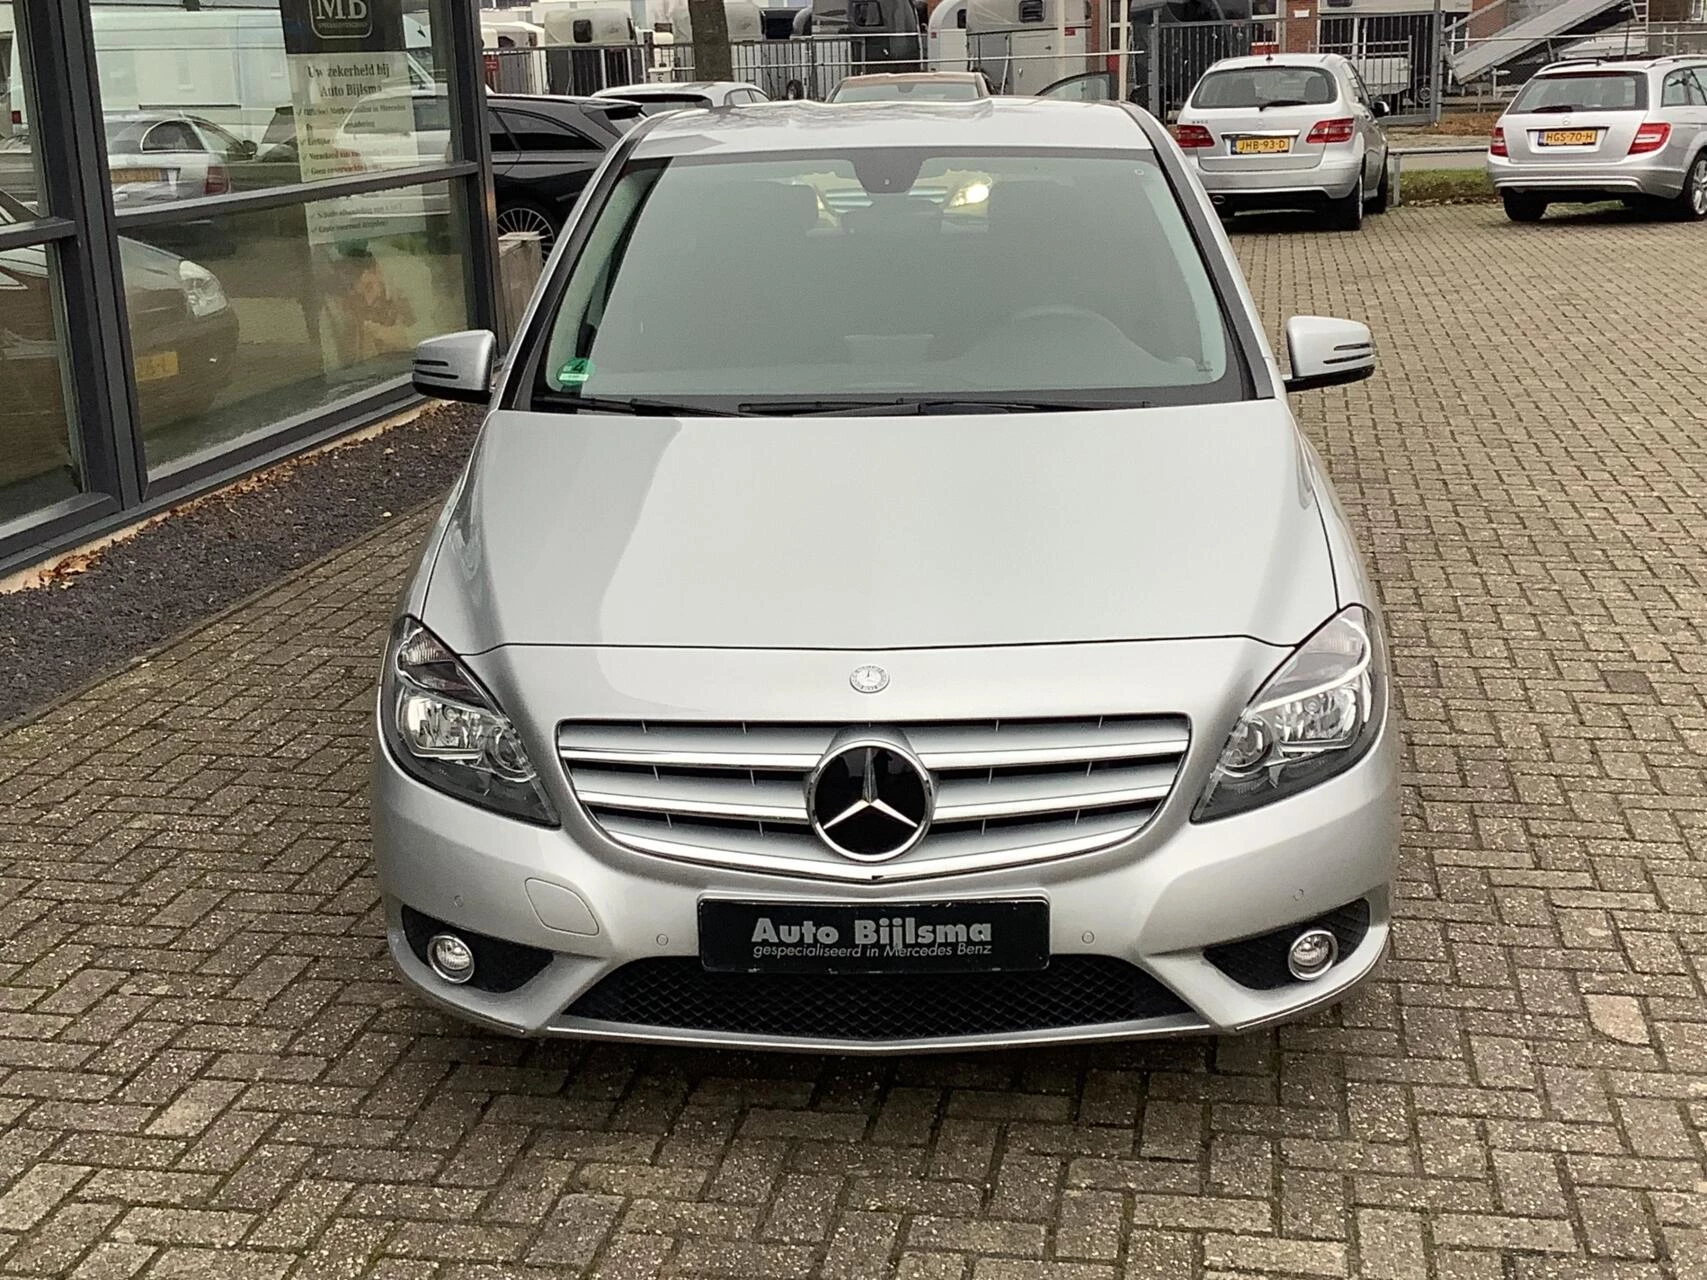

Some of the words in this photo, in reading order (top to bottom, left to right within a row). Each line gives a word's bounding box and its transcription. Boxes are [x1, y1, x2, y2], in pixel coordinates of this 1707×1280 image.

[327, 64, 375, 78] zekerheid
[376, 63, 390, 78] bij
[320, 86, 344, 97] Auto
[345, 83, 383, 98] Bijlsma
[1239, 139, 1286, 150] JHB-93-D
[1546, 132, 1593, 142] HGS-70-H
[572, 360, 585, 373] 4
[751, 917, 839, 944] Auto
[855, 917, 992, 949] Bijlsma
[753, 943, 862, 959] gespecialiseerd
[867, 944, 879, 957] in
[883, 943, 953, 957] Mercedes
[957, 942, 992, 955] Benz
